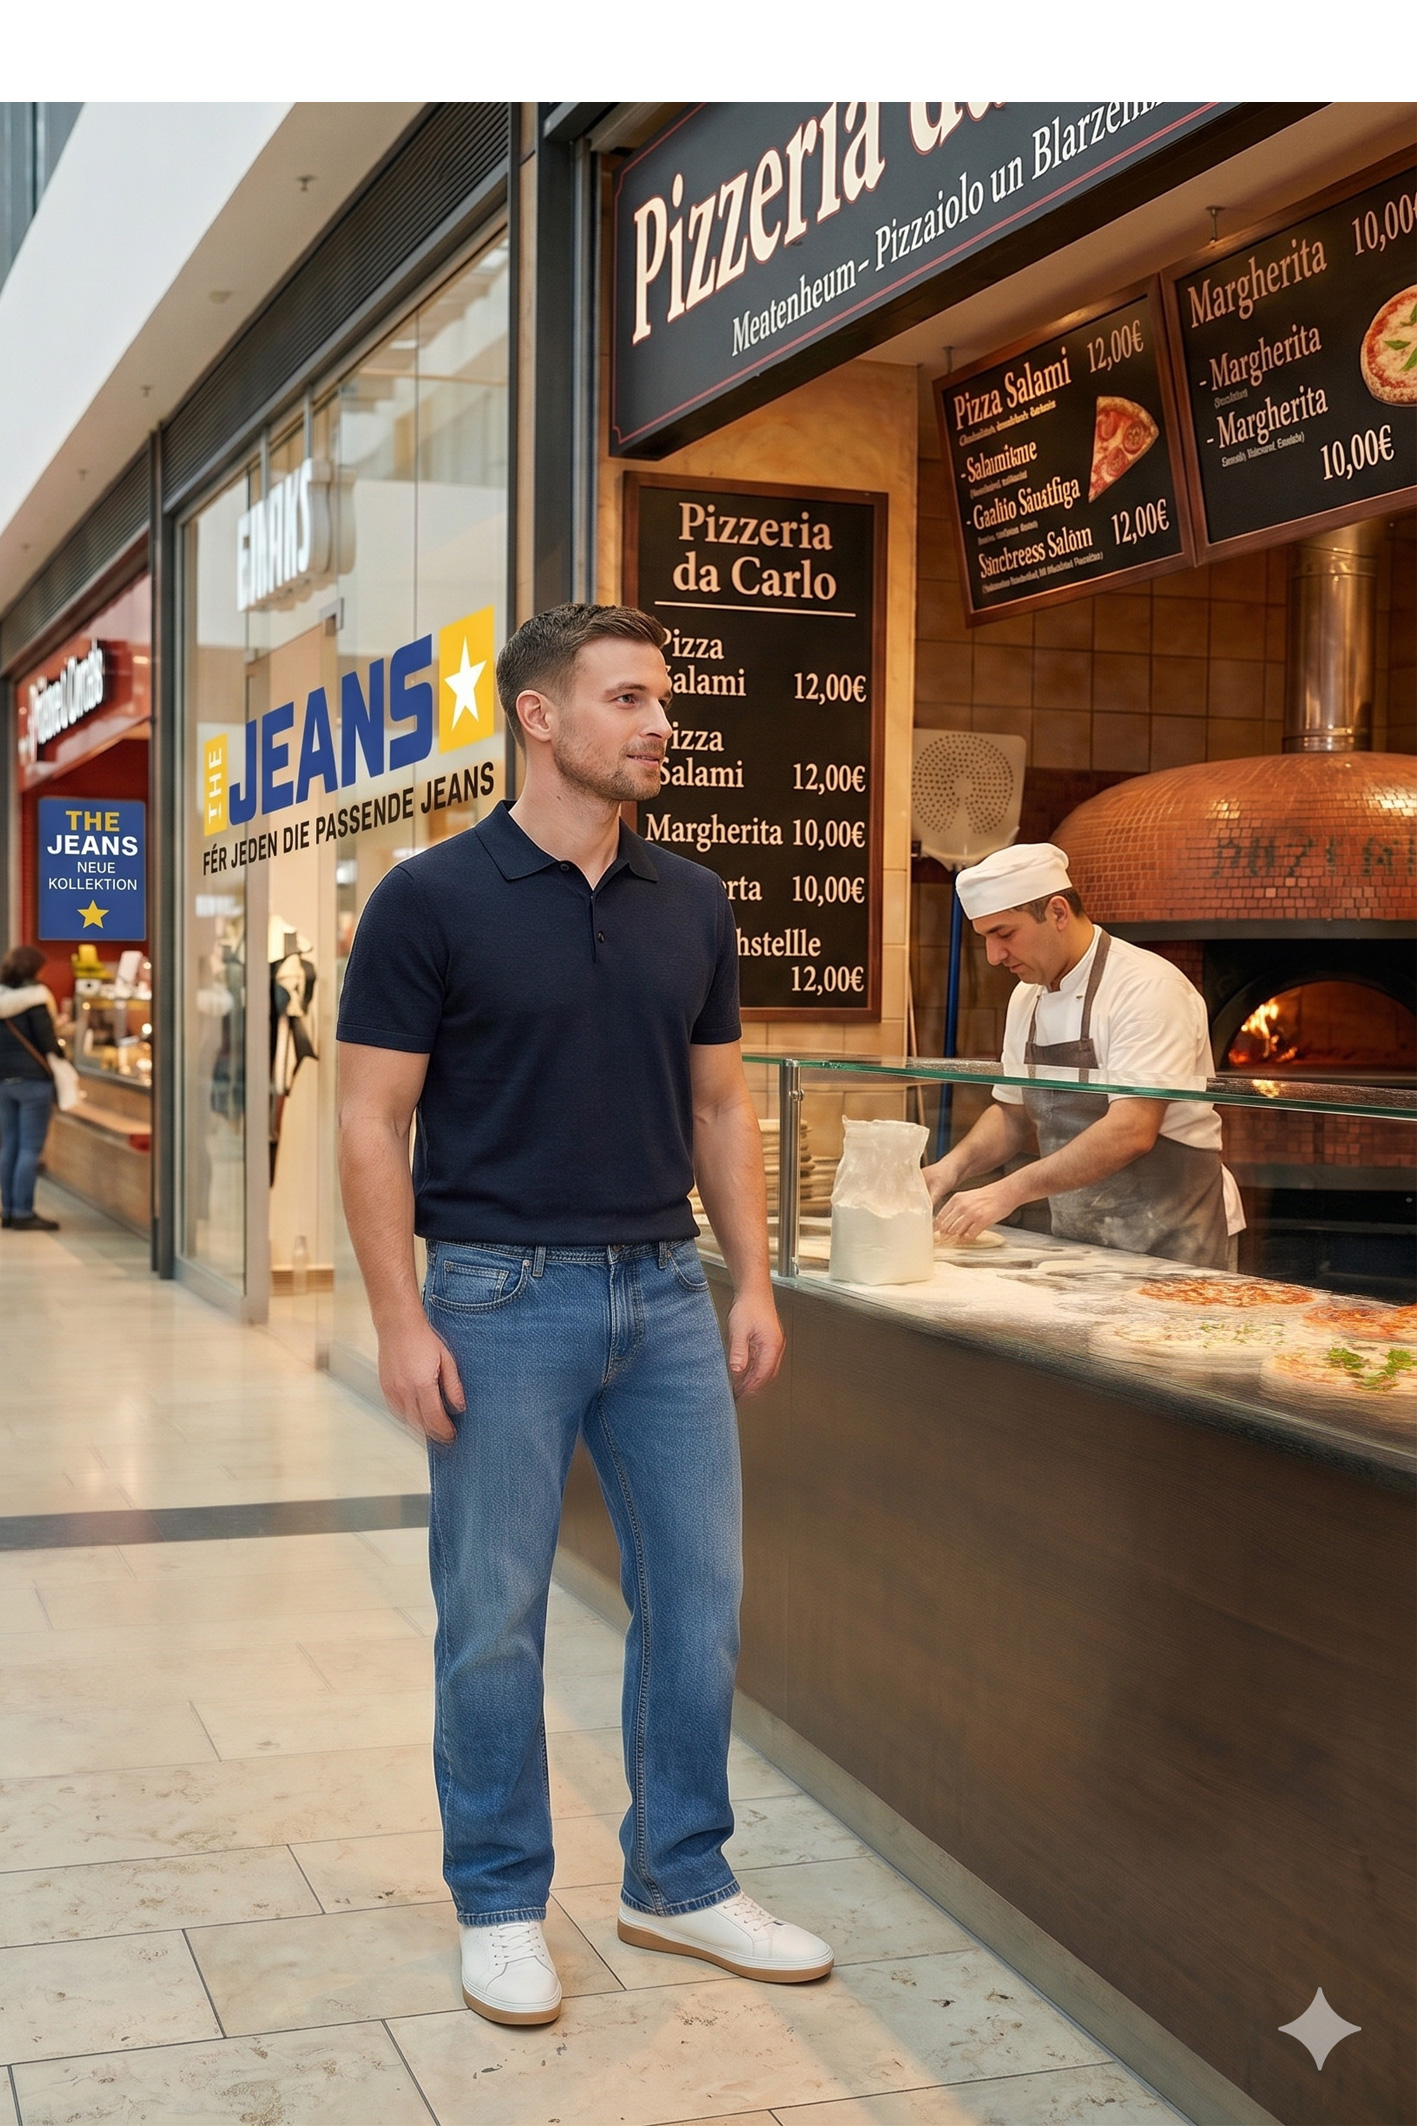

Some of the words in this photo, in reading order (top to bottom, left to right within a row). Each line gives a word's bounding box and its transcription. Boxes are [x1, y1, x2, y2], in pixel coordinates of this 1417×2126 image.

[632, 102, 886, 345] Pizzeria
[875, 171, 984, 272] Pizzaiolo
[990, 155, 1024, 203] un
[1187, 239, 1328, 329] Margherita
[1351, 191, 1417, 256] 10,00
[953, 388, 1004, 431] Pizza
[1004, 346, 1072, 409] Salami
[1086, 319, 1145, 374] 12,00€
[1319, 424, 1395, 481] 10,00€
[678, 502, 833, 551] Pizzeria
[1110, 498, 1170, 546] 12,00€
[672, 550, 721, 593] da
[731, 555, 837, 600] Carlo
[665, 665, 747, 697] alami
[794, 672, 867, 705] 12,00€
[228, 634, 433, 826] JEANS
[670, 721, 725, 752] izza
[208, 747, 222, 825] THE
[792, 762, 866, 796] 12,00€
[65, 810, 120, 832] THE
[231, 830, 278, 869] JEDEN
[283, 823, 310, 854] DIE
[315, 786, 414, 846] PASSENDE
[420, 761, 495, 814] JEANS
[645, 813, 783, 853] Margherita
[792, 819, 866, 851] 10,00€
[47, 834, 139, 857] JEANS
[76, 861, 116, 874] NEUE
[48, 877, 138, 891] KOLLEKTION
[721, 875, 763, 901] rta
[792, 875, 865, 907] 10,00€
[791, 965, 864, 995] 12,00€
